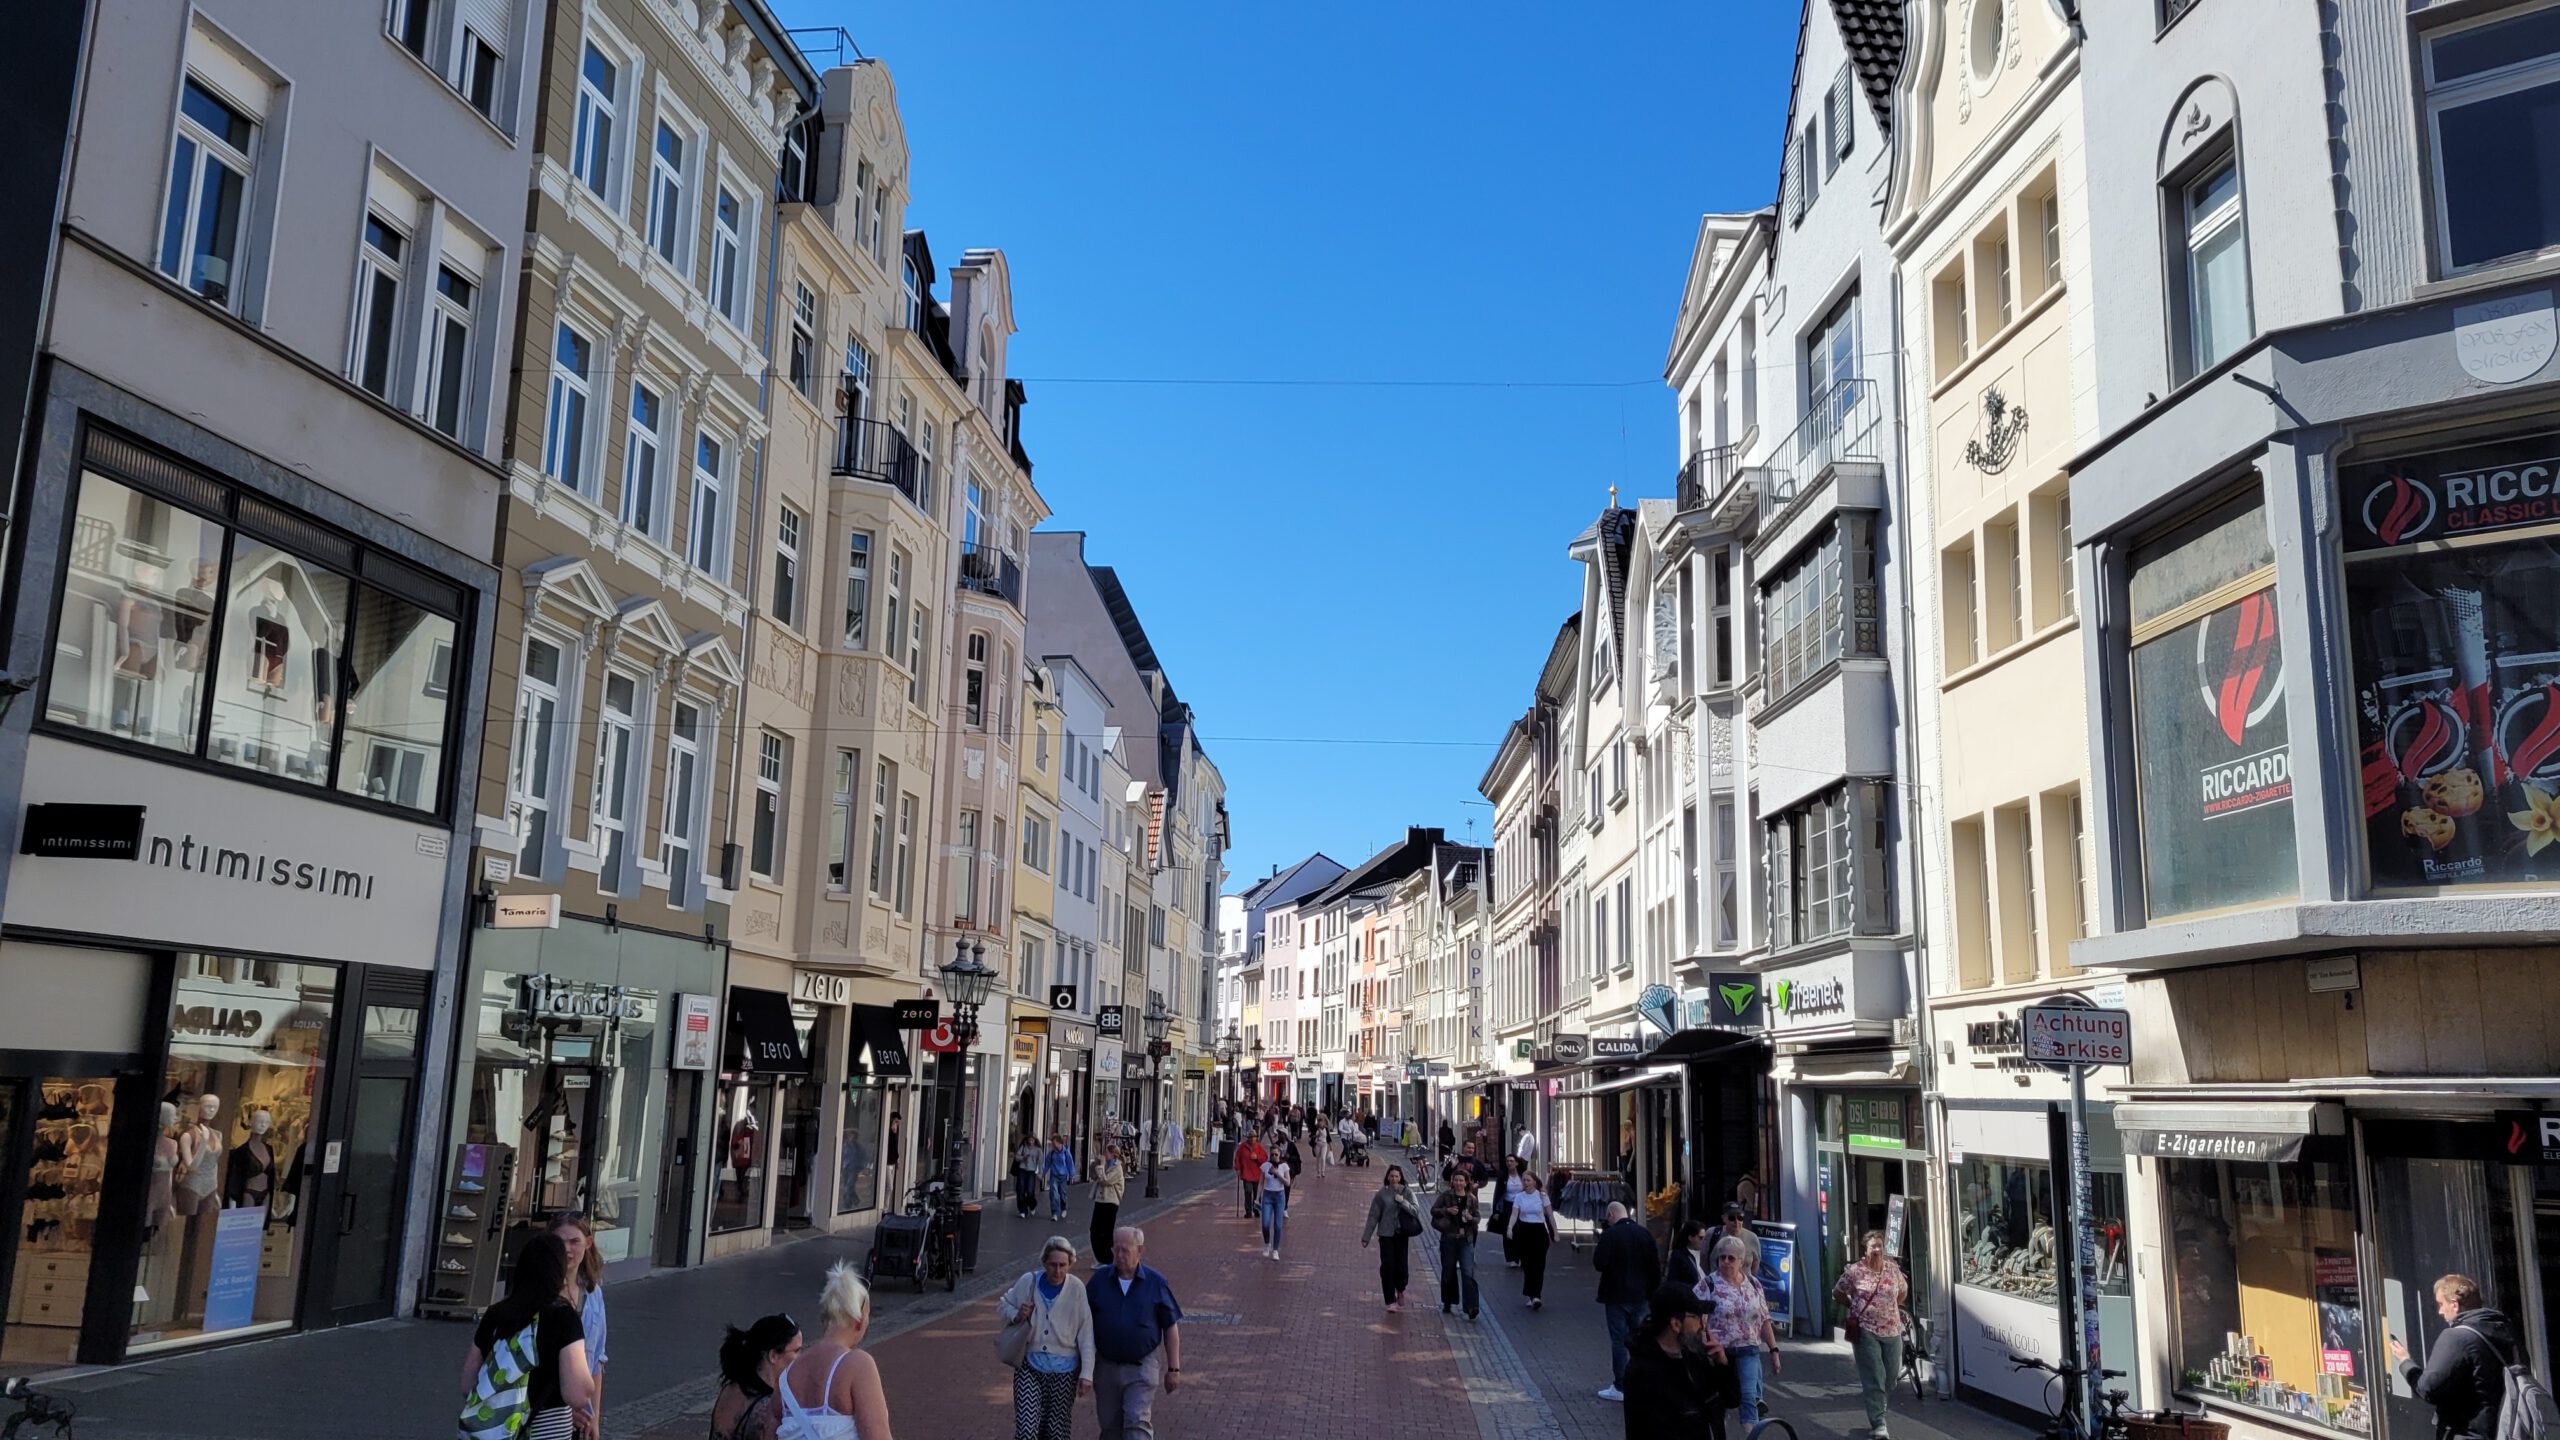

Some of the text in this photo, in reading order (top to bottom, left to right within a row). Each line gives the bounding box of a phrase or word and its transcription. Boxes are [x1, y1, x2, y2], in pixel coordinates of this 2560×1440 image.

[2447, 500, 2546, 529] CLASSIC
[148, 834, 374, 900] ntimissimi
[2423, 857, 2482, 873] Riccardo
[500, 907, 547, 916] Tamaris
[440, 995, 448, 1009] 3
[1471, 947, 1482, 1039] OPTIK
[1789, 979, 1843, 1011] freenet
[902, 1009, 932, 1018] zero
[2032, 1012, 2123, 1039] Achtung
[760, 1041, 791, 1060] zero
[1555, 1044, 1585, 1054] ONLY
[1597, 1042, 1639, 1053] CALIDA
[2034, 1039, 2123, 1059] arkise
[877, 1050, 901, 1065] zero
[1407, 1066, 1422, 1074] WC
[1849, 1104, 1865, 1124] DSL
[2158, 1133, 2256, 1156] E-Zigaretten
[487, 1152, 514, 1242] Tamaris
[1765, 1228, 1788, 1239] freenet
[2014, 1333, 2040, 1354] GOLD
